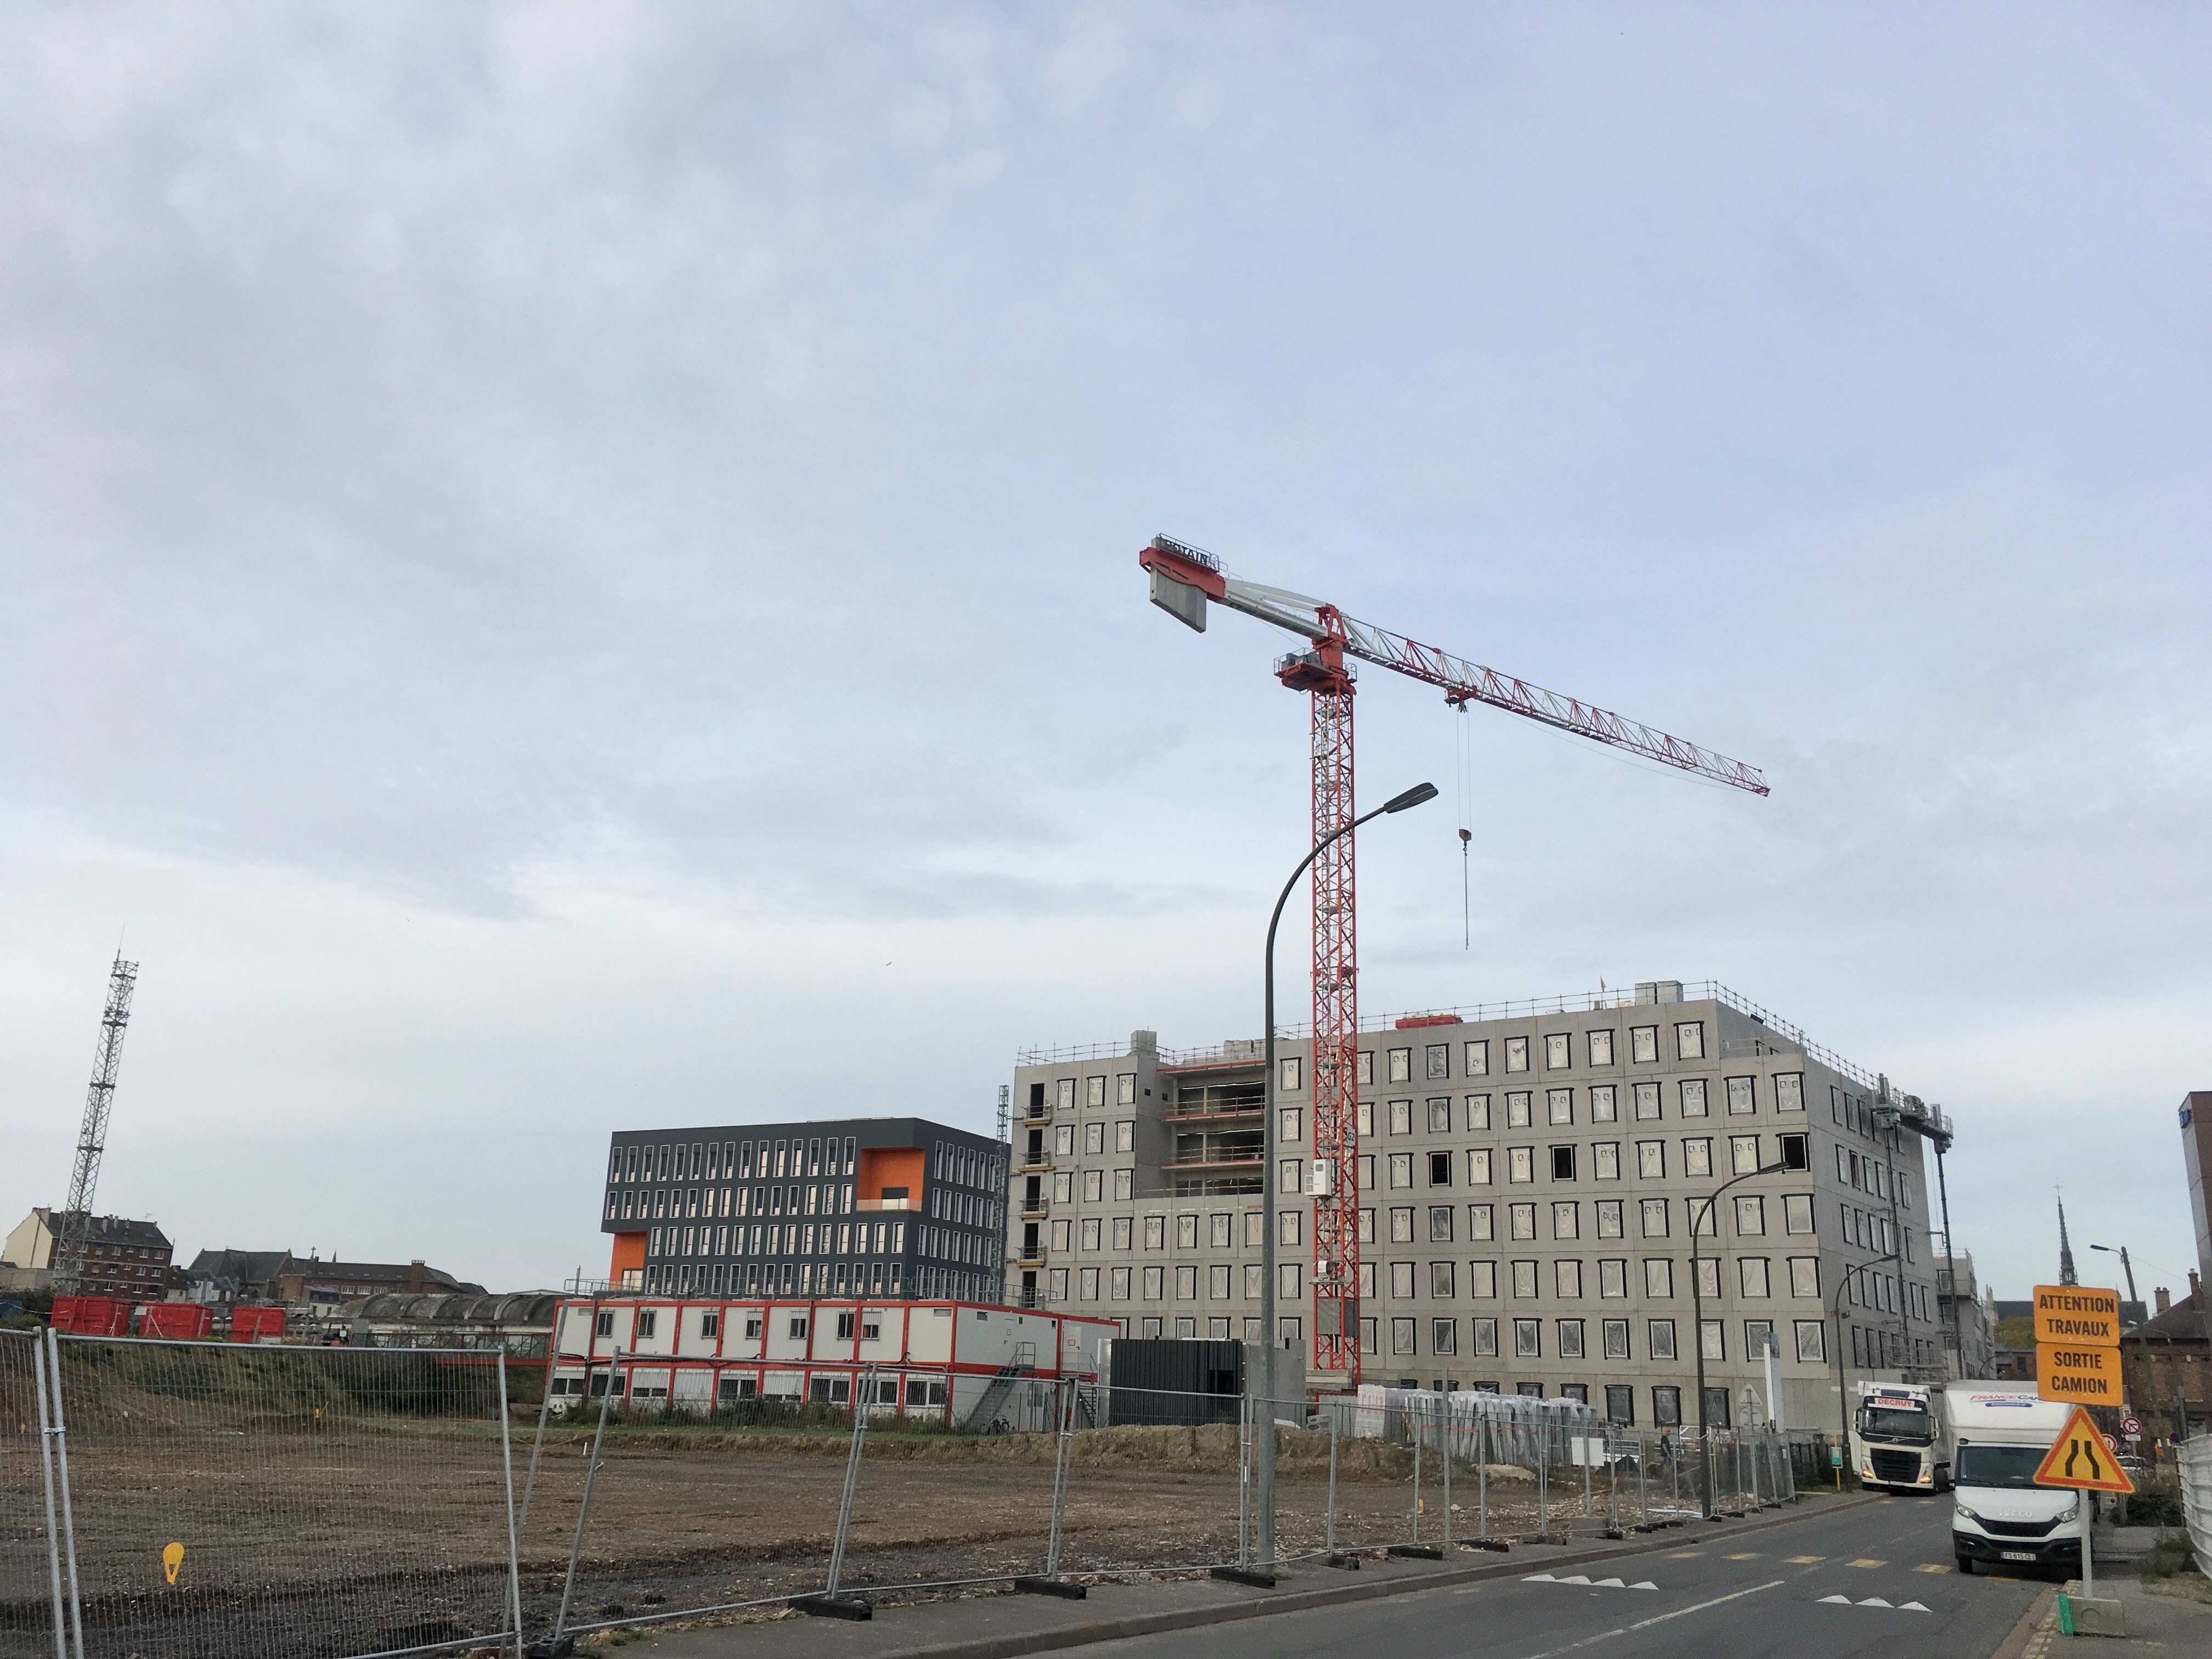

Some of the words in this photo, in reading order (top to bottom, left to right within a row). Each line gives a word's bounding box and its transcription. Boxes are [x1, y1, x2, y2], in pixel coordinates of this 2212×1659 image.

[1347, 1132, 1355, 1141] G2
[2039, 1294, 2115, 1313] ATTENTION
[2047, 1318, 2109, 1337] TRAVAUX
[2054, 1352, 2102, 1369] SORTIE
[2052, 1376, 2107, 1394] CAMION
[1878, 1398, 1912, 1407] DECRUY
